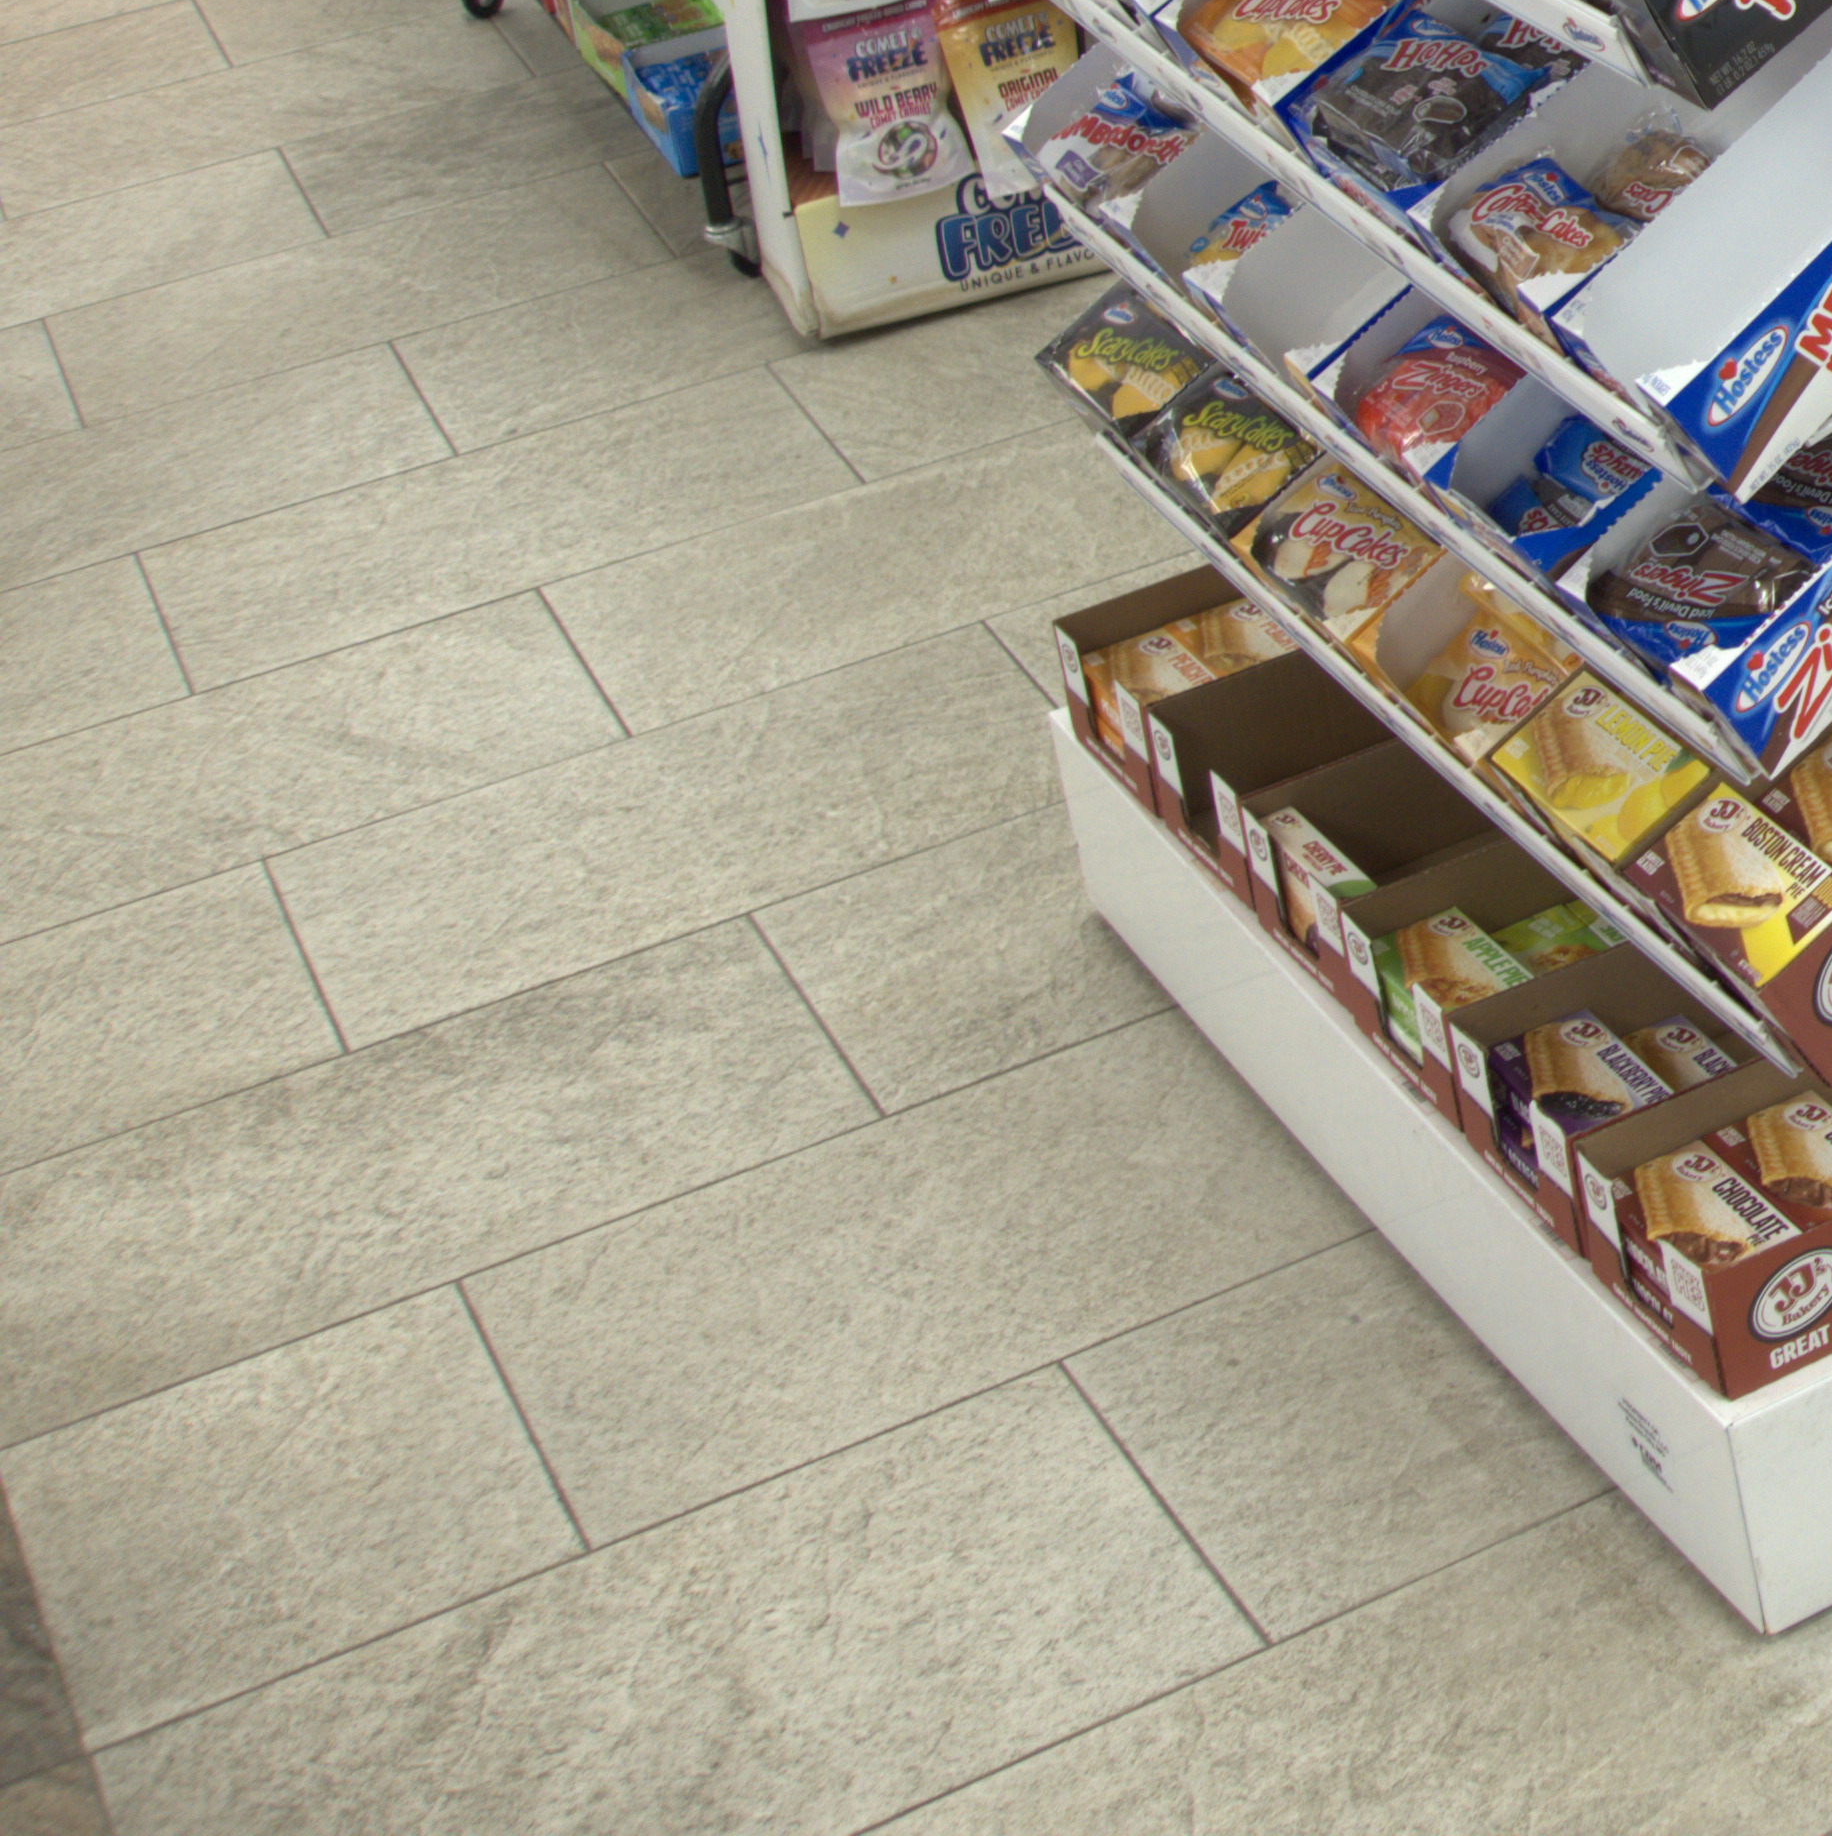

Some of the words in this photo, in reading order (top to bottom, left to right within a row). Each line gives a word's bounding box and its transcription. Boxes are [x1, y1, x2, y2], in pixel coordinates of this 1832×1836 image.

[855, 93, 895, 117] WILD
[898, 84, 939, 107] BERRY
[999, 67, 1059, 100] ORIGINAL
[960, 265, 1015, 292] UNIQUE
[1077, 328, 1179, 369] ScaryCakes
[1597, 708, 1641, 752] LEMON
[1641, 737, 1674, 772] PIE
[1713, 1177, 1789, 1241] CHOCOLATE
[1770, 1326, 1829, 1369] GREAT
